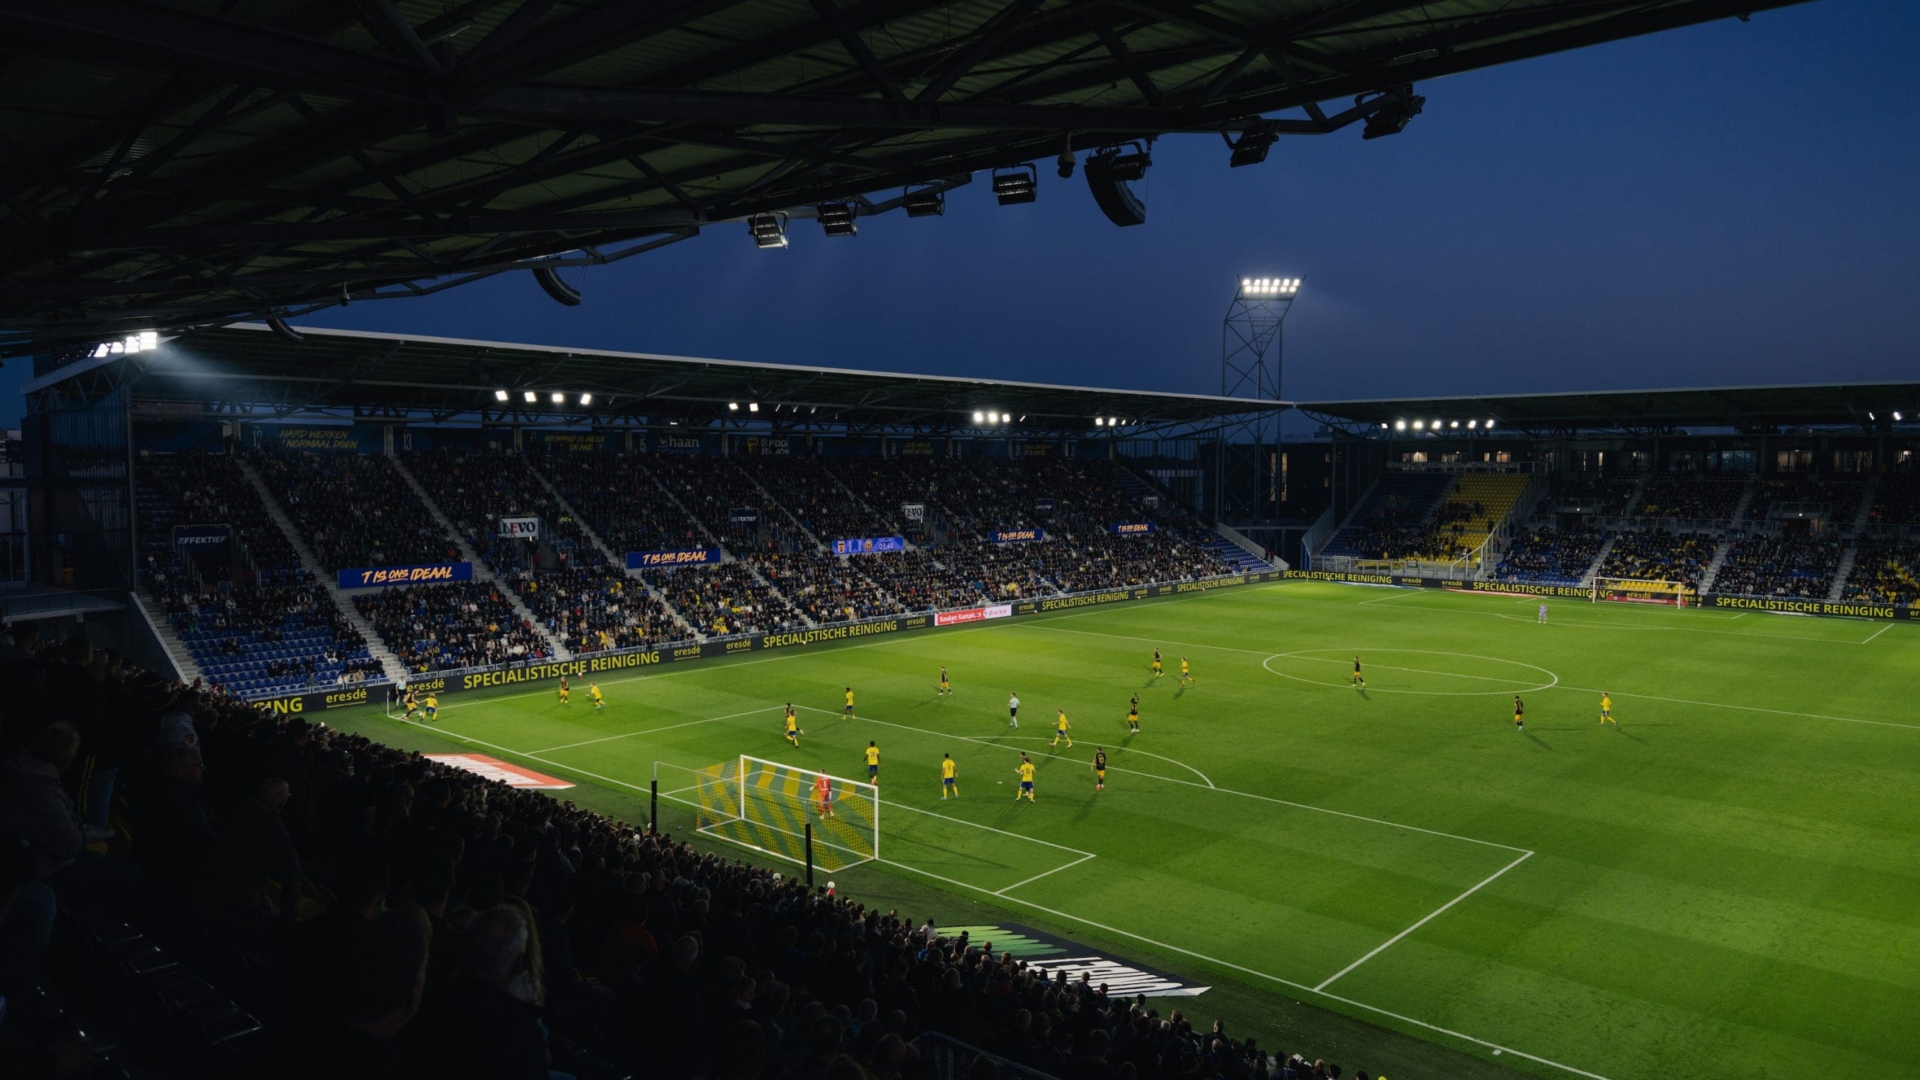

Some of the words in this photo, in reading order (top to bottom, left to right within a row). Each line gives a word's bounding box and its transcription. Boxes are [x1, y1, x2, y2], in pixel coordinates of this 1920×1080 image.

[280, 430, 307, 439] HARD
[309, 430, 348, 440] WERKEN
[403, 433, 412, 450] 13
[668, 436, 700, 448] haan
[286, 440, 330, 448] NORMAAL
[650, 554, 661, 564] IS
[676, 551, 707, 562] IDEAAL
[373, 570, 388, 583] IS
[388, 568, 408, 580] ONS
[410, 566, 452, 581] IDEAAL
[1283, 570, 1346, 582] SPECIALISTISCHE
[1348, 573, 1392, 584] REINIGING
[1473, 581, 1555, 595] SPECIALISTISCHE
[1558, 588, 1614, 600] REINIGNG
[1042, 597, 1096, 611] SPECIALISTISCHE
[1097, 591, 1128, 604] REINIGING
[1716, 598, 1820, 613] SPECIALISTISCHE
[1823, 602, 1894, 618] REINIGING
[906, 616, 926, 626] eresdé
[763, 626, 847, 648] SPECIALISTISCHE
[848, 619, 898, 638] REINIGING
[674, 645, 701, 657] eresdé
[726, 638, 752, 650] eresdé
[464, 660, 587, 689] SPECIALISTISCHE
[590, 651, 660, 672] REINIGING
[326, 688, 368, 704] eresdé
